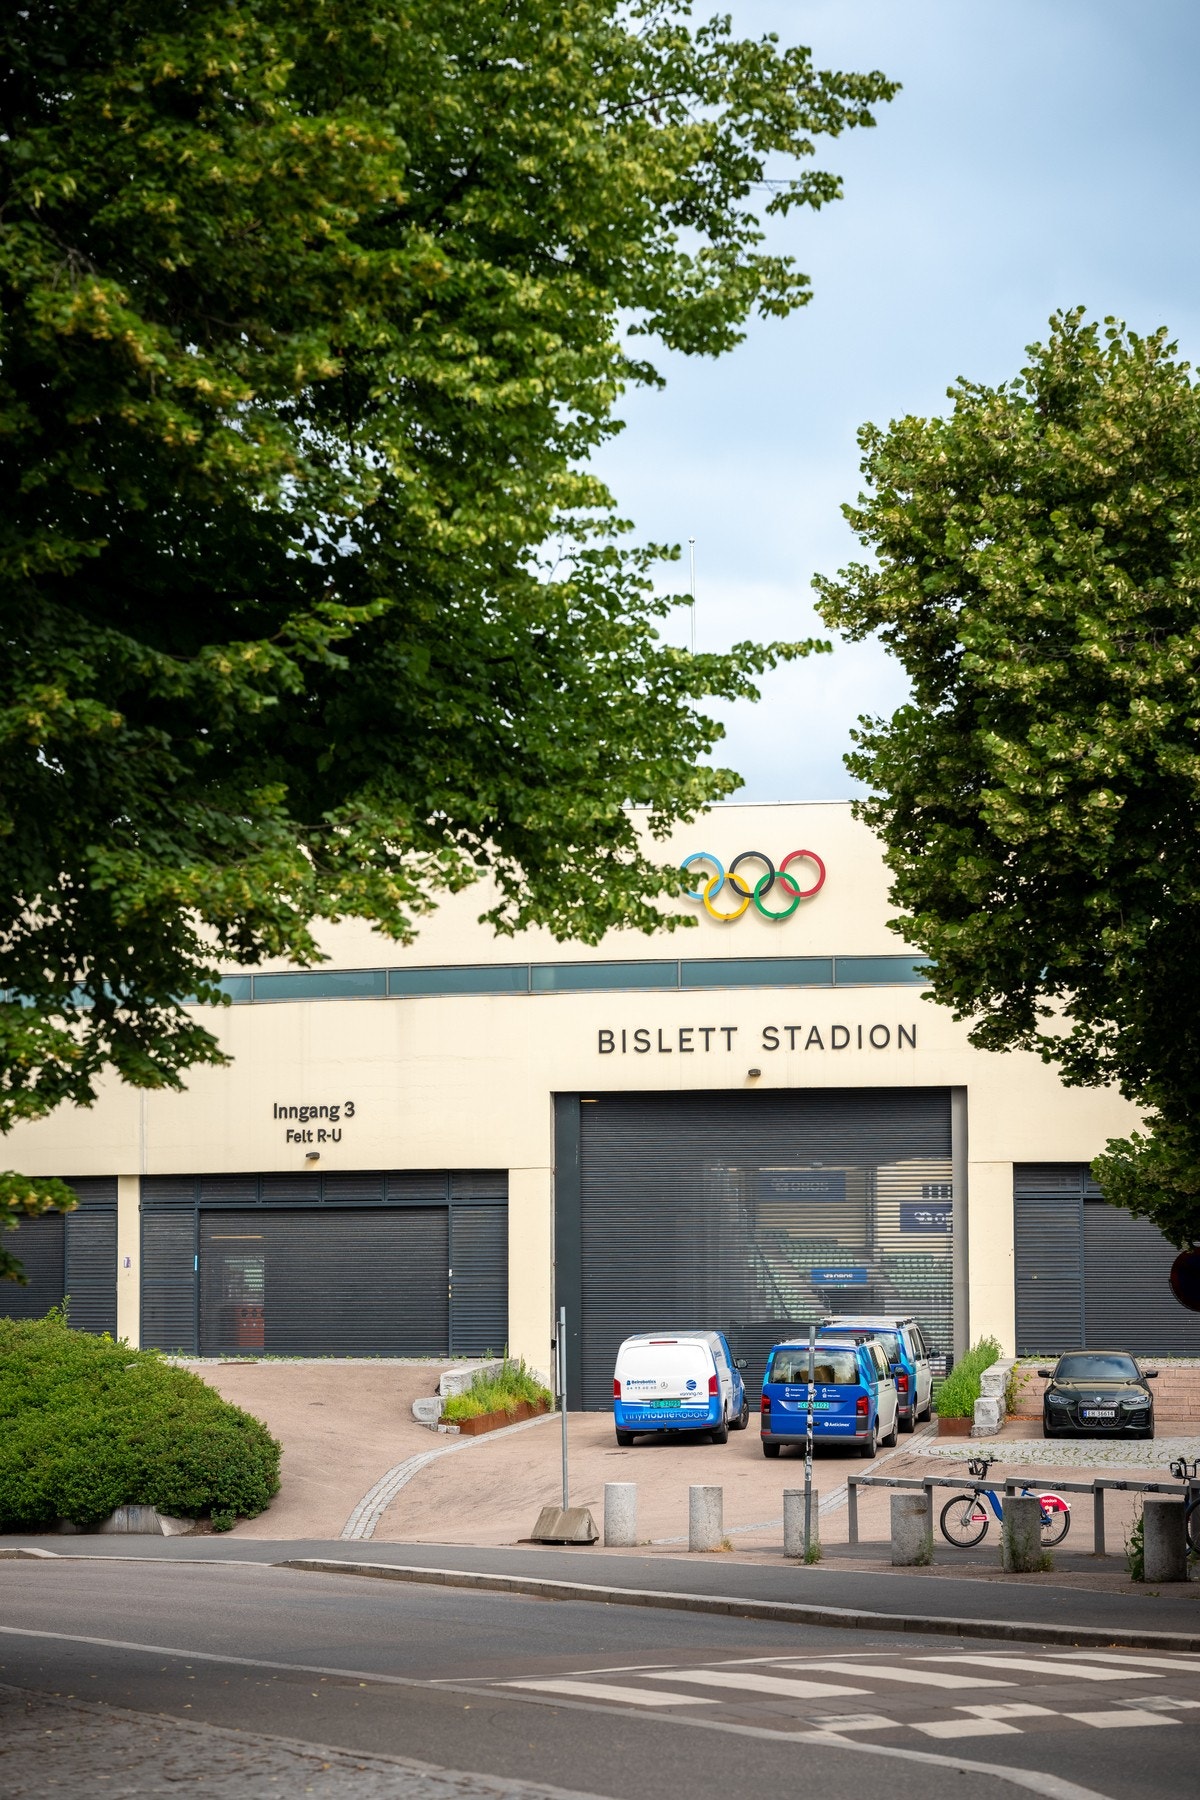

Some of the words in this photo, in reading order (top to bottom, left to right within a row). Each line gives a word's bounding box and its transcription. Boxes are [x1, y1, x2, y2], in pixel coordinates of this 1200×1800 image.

[598, 1026, 738, 1054] BISLETT
[761, 1023, 917, 1051] STADION
[273, 1102, 341, 1123] Inngang
[344, 1100, 355, 1118] 3
[286, 1129, 314, 1143] Felt
[317, 1128, 342, 1142] R-U
